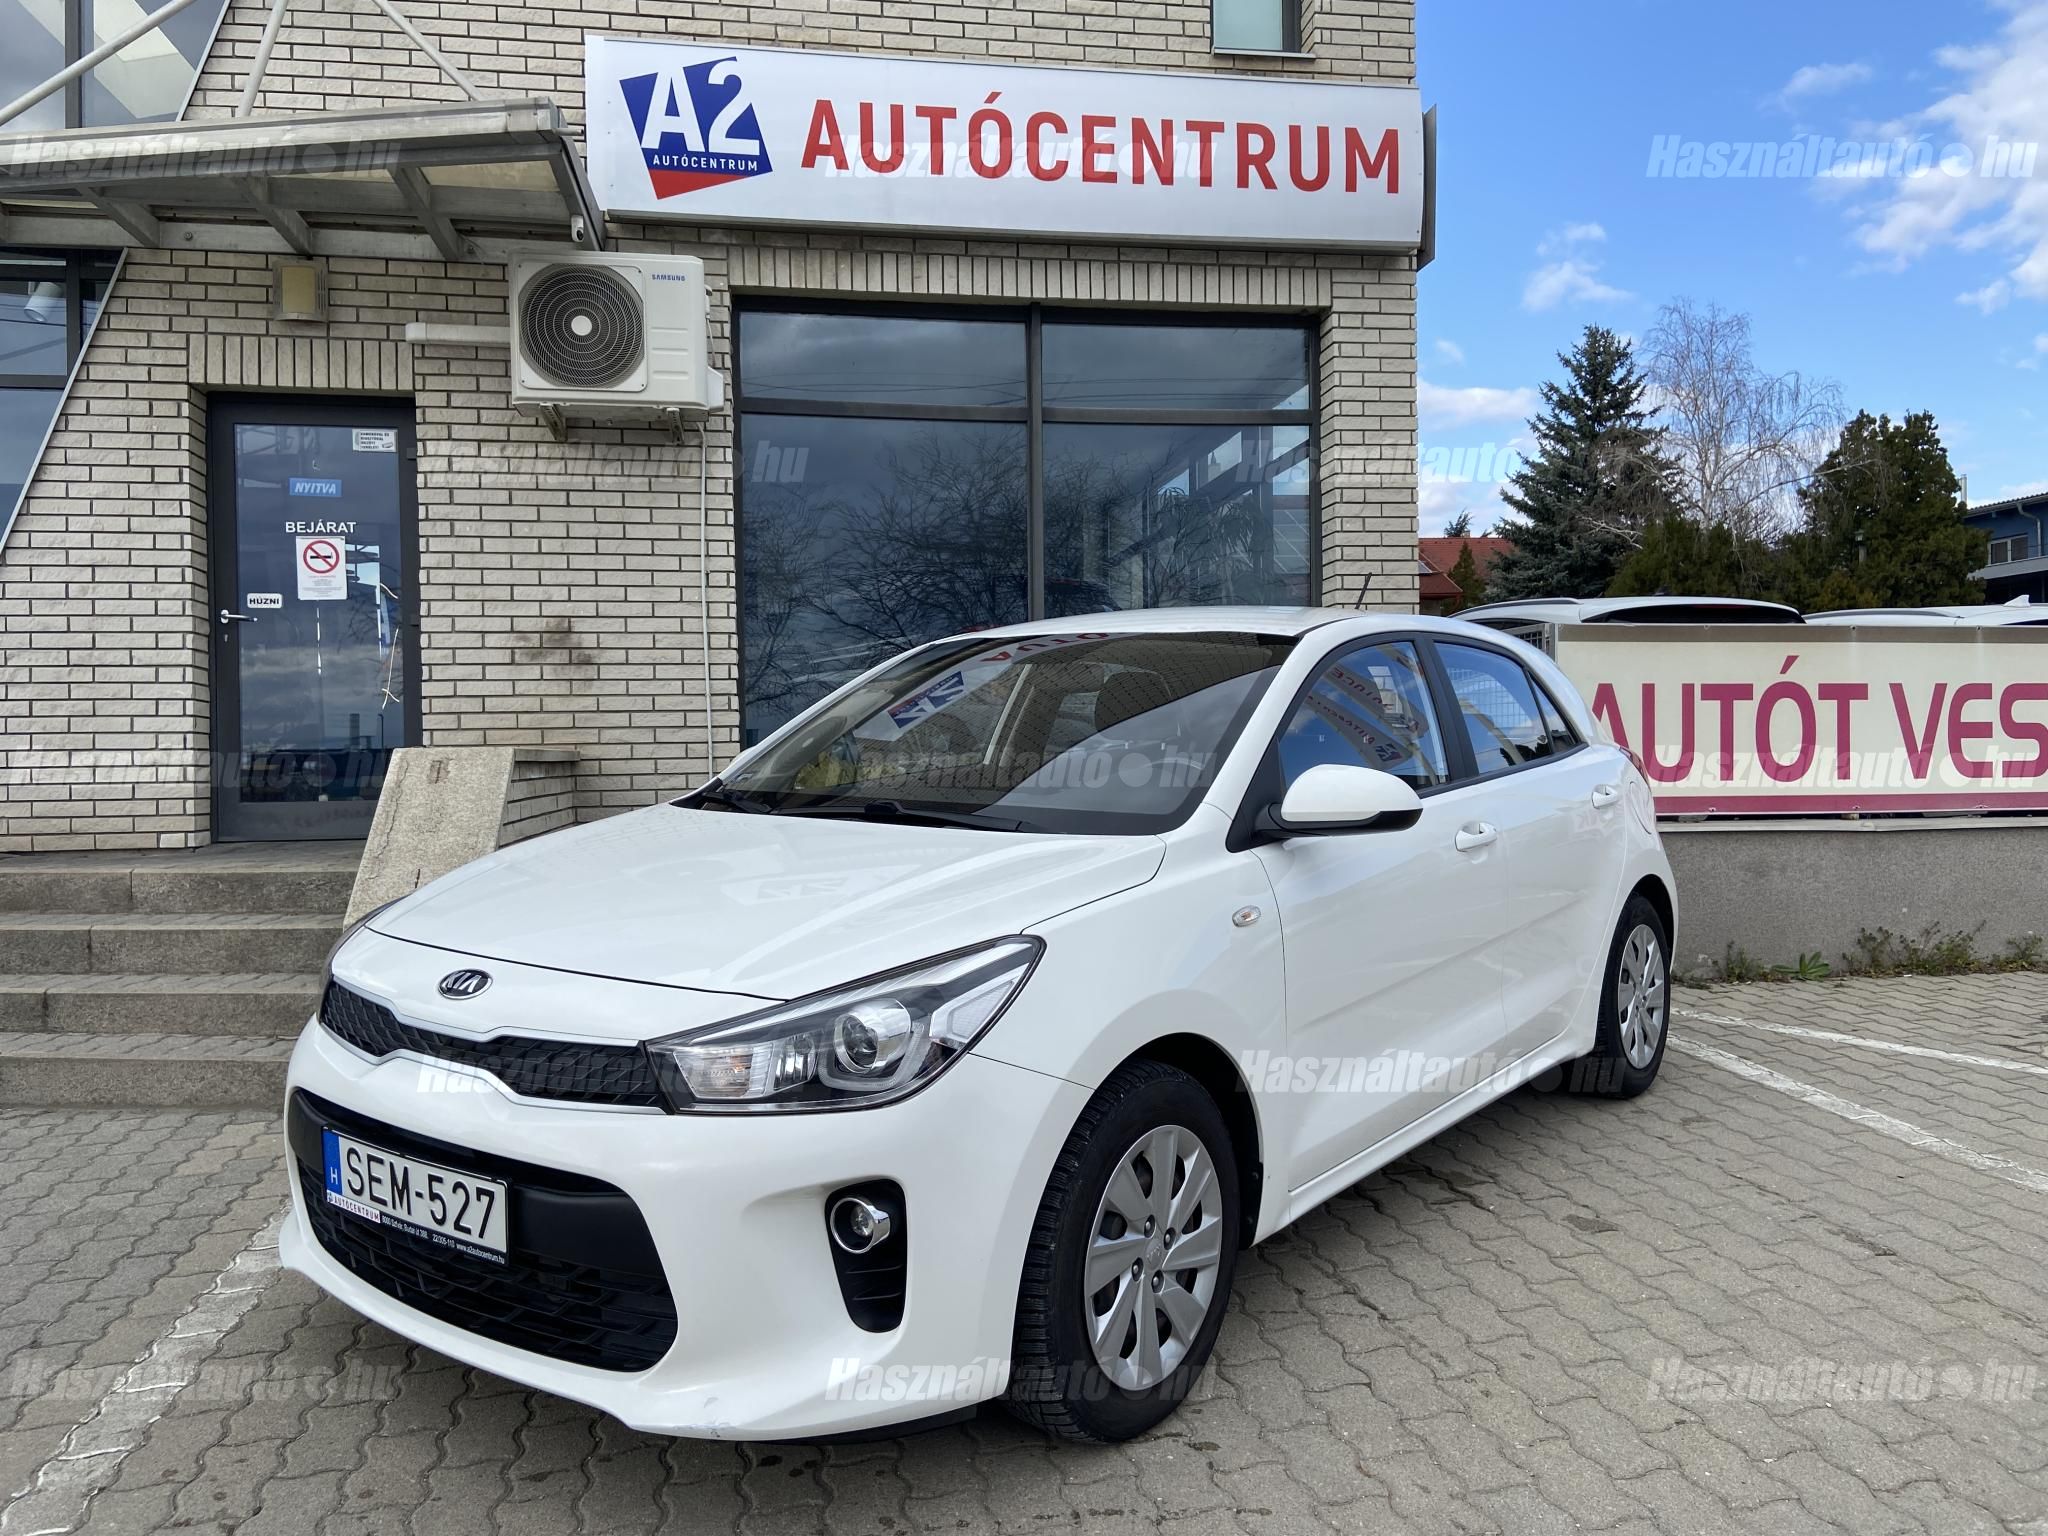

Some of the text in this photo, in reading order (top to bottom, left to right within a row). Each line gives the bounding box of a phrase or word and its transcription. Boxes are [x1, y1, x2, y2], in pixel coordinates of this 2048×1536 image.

[640, 60, 761, 156] A2
[800, 91, 1399, 194] AUTÓCENTRUM
[653, 154, 758, 172] AUTÓCENTRUM
[651, 273, 686, 282] SAMSUNG
[294, 482, 337, 495] NYITVA
[285, 518, 357, 533] BEJÁRAT
[249, 596, 280, 605] HÚZNI
[330, 1168, 338, 1184] H
[346, 1147, 495, 1240] SEM-527
